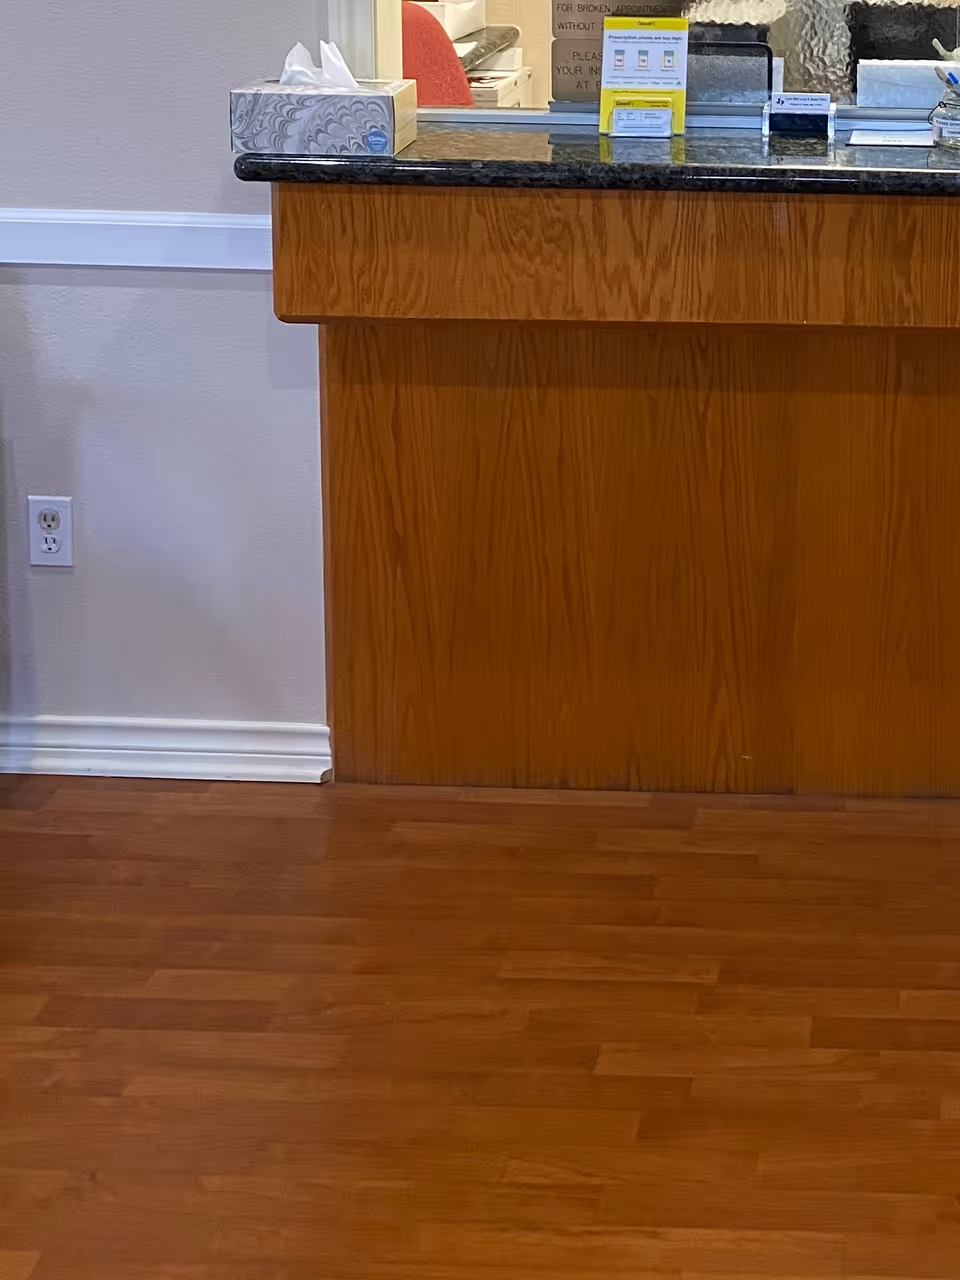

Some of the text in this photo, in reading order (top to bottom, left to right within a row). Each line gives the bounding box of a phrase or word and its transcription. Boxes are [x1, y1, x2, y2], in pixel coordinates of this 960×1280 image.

[557, 4, 573, 12] FOR
[578, 4, 610, 13] BROKEN
[557, 23, 595, 31] WITHOUT
[572, 52, 602, 61] PLEAS
[556, 66, 582, 75] YOUR
[576, 81, 588, 89] AT
